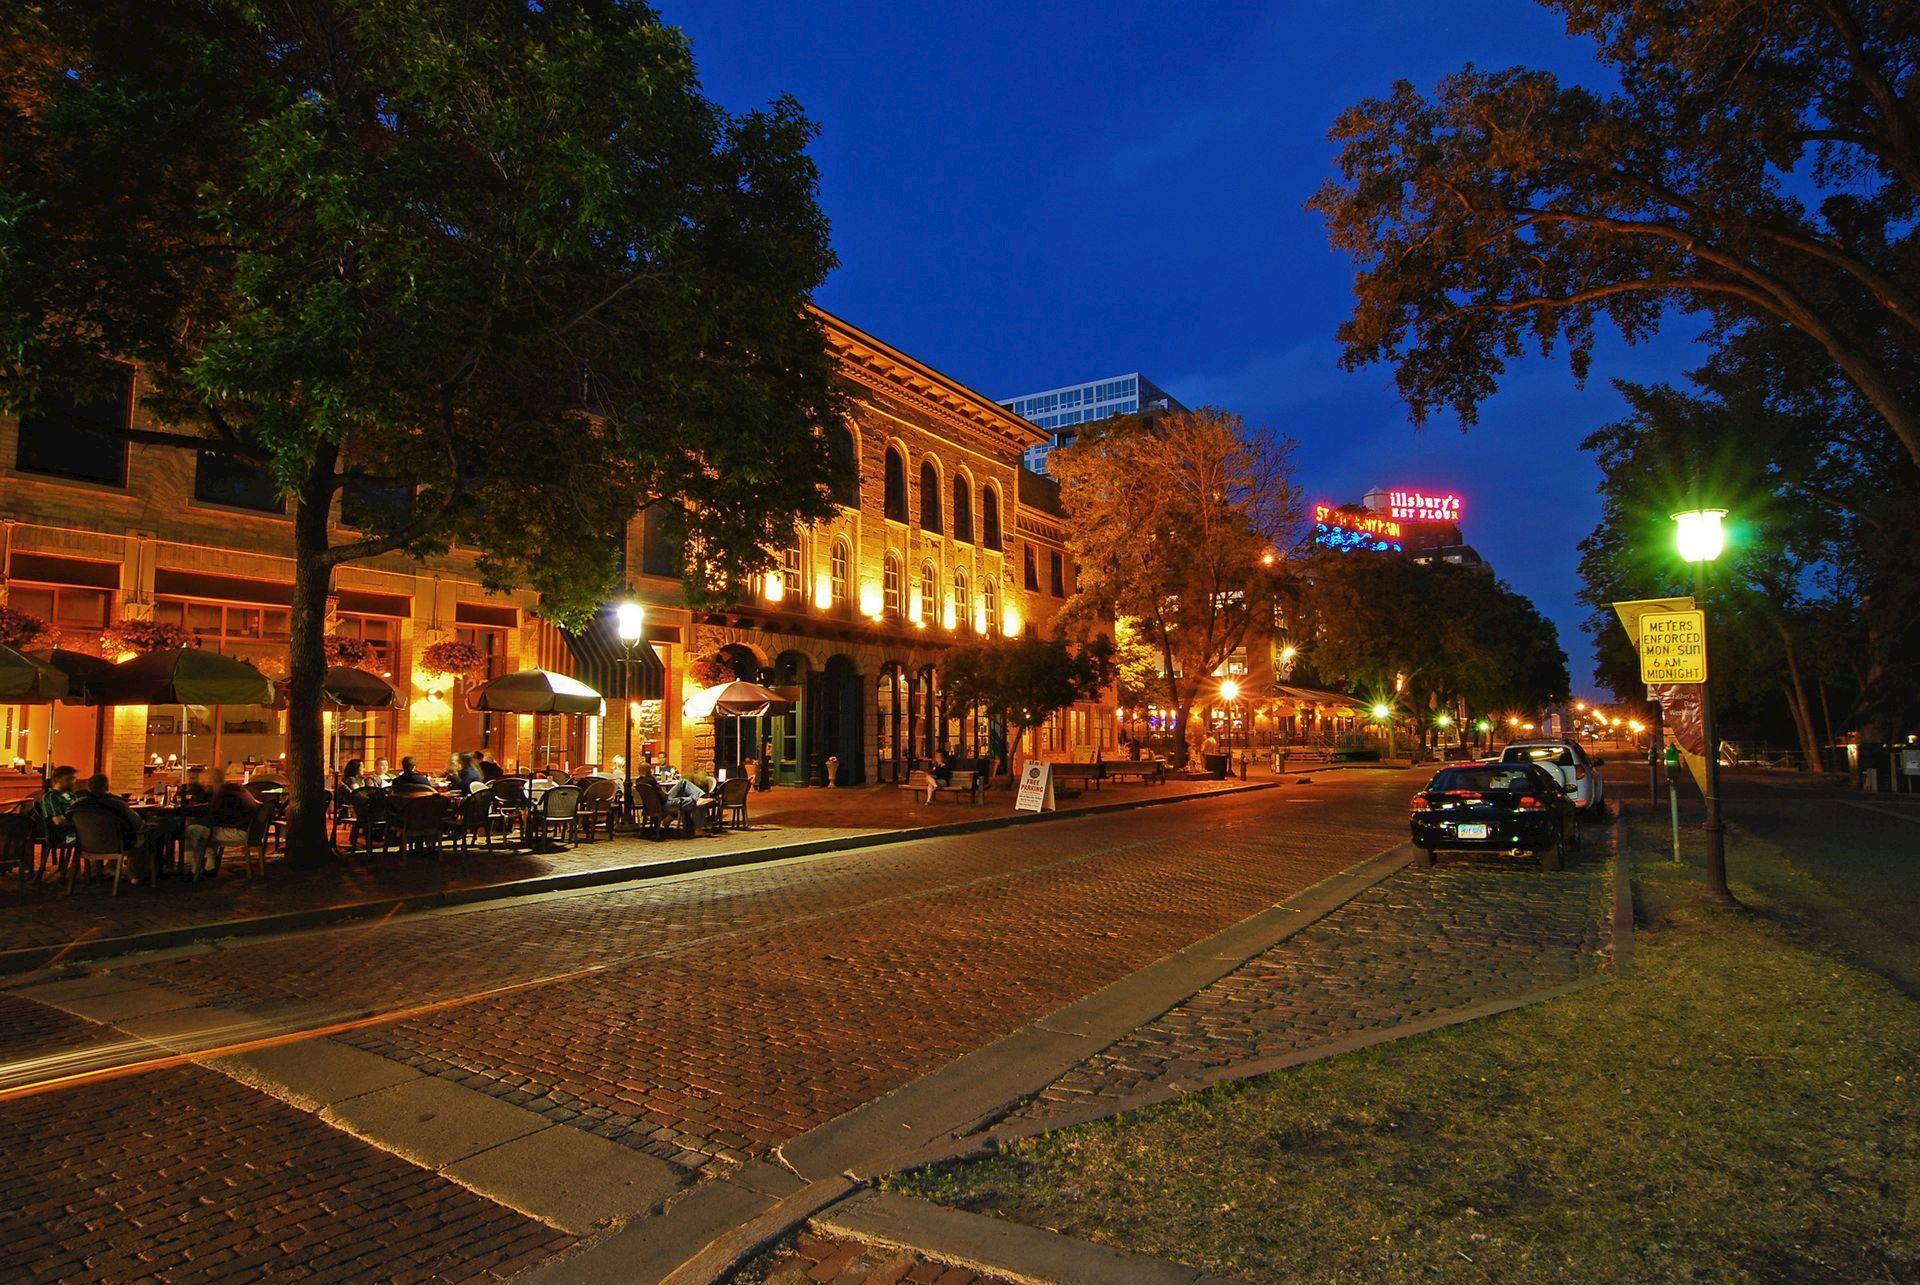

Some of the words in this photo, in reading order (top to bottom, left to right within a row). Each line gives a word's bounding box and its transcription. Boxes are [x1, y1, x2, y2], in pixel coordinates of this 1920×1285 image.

[1649, 621, 1693, 632] METERS
[1643, 633, 1700, 644] ENFORCED
[1653, 659, 1661, 667] 6
[1647, 668, 1699, 679] MIDNIGHT
